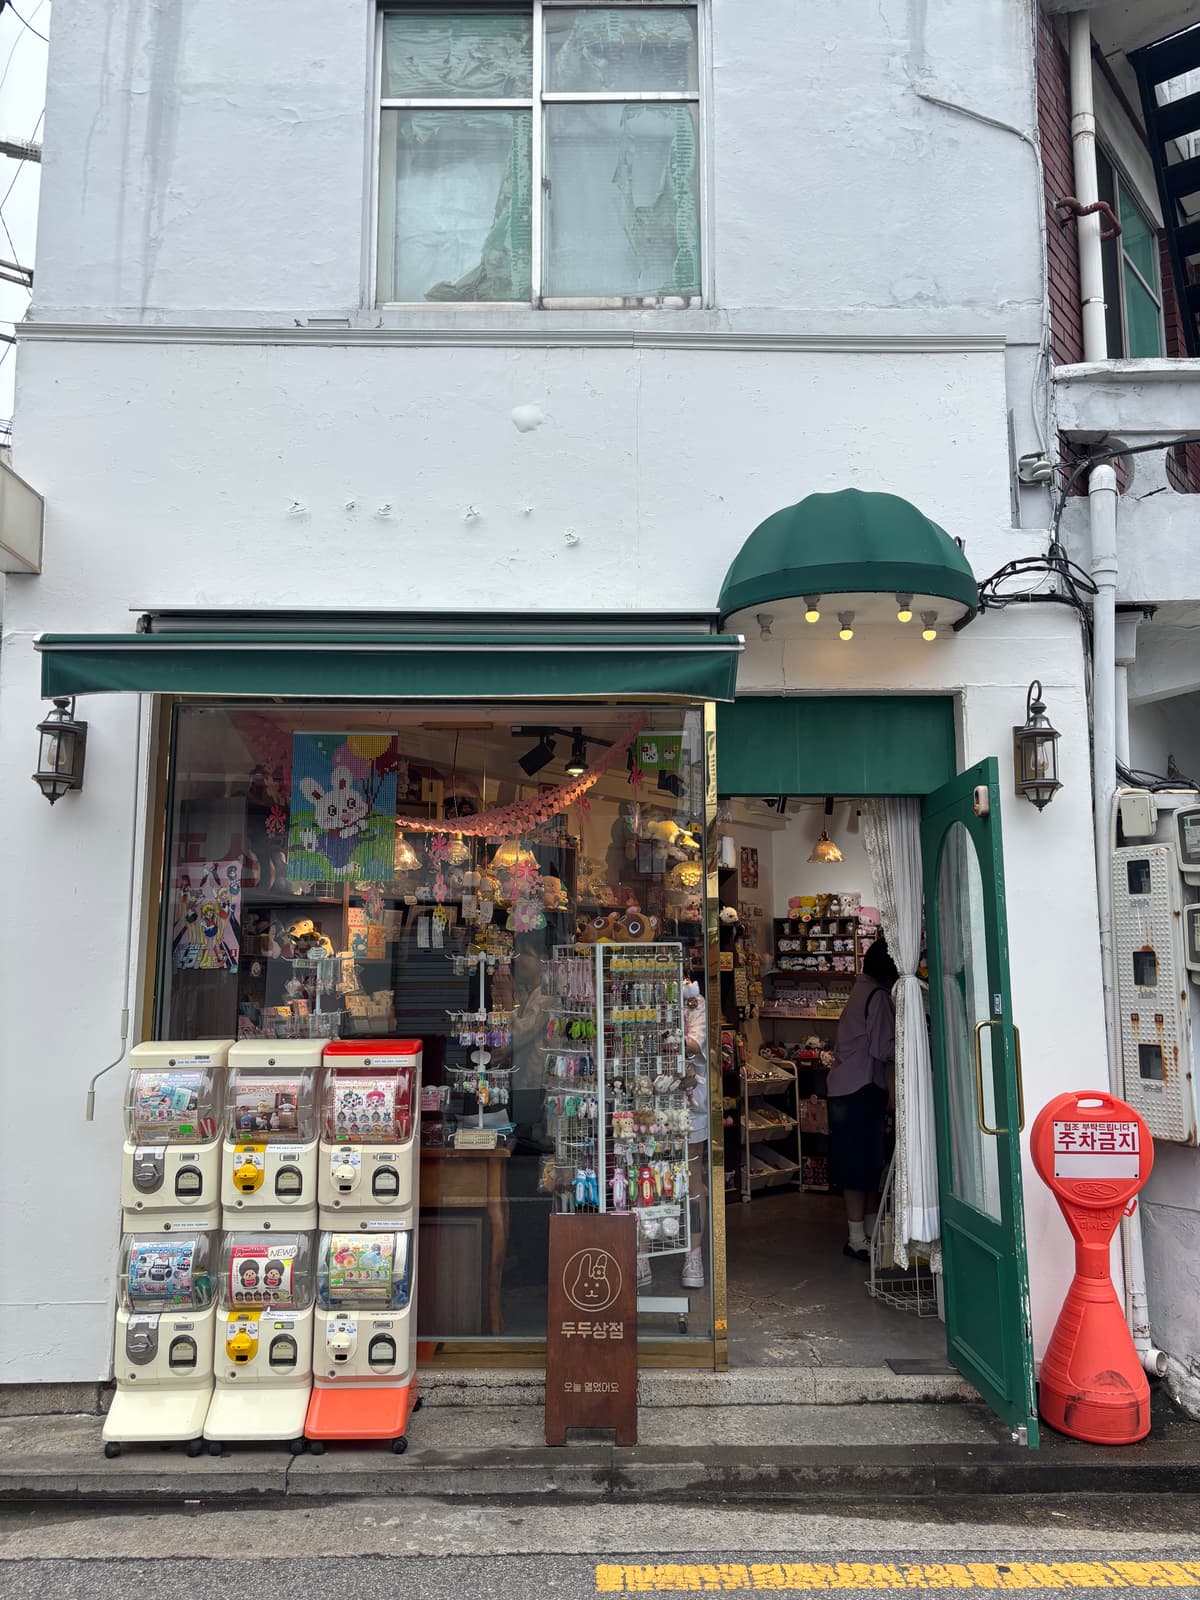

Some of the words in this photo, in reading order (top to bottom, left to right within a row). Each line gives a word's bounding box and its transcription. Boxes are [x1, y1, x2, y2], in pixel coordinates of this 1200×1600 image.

[1063, 1123, 1080, 1131] 협조
[1082, 1123, 1130, 1132] 부탁드립니다
[1058, 1131, 1136, 1151] 주차금지
[561, 1322, 624, 1339] 두두상점
[563, 1382, 582, 1393] 오늘
[584, 1382, 620, 1393] 열었어요
